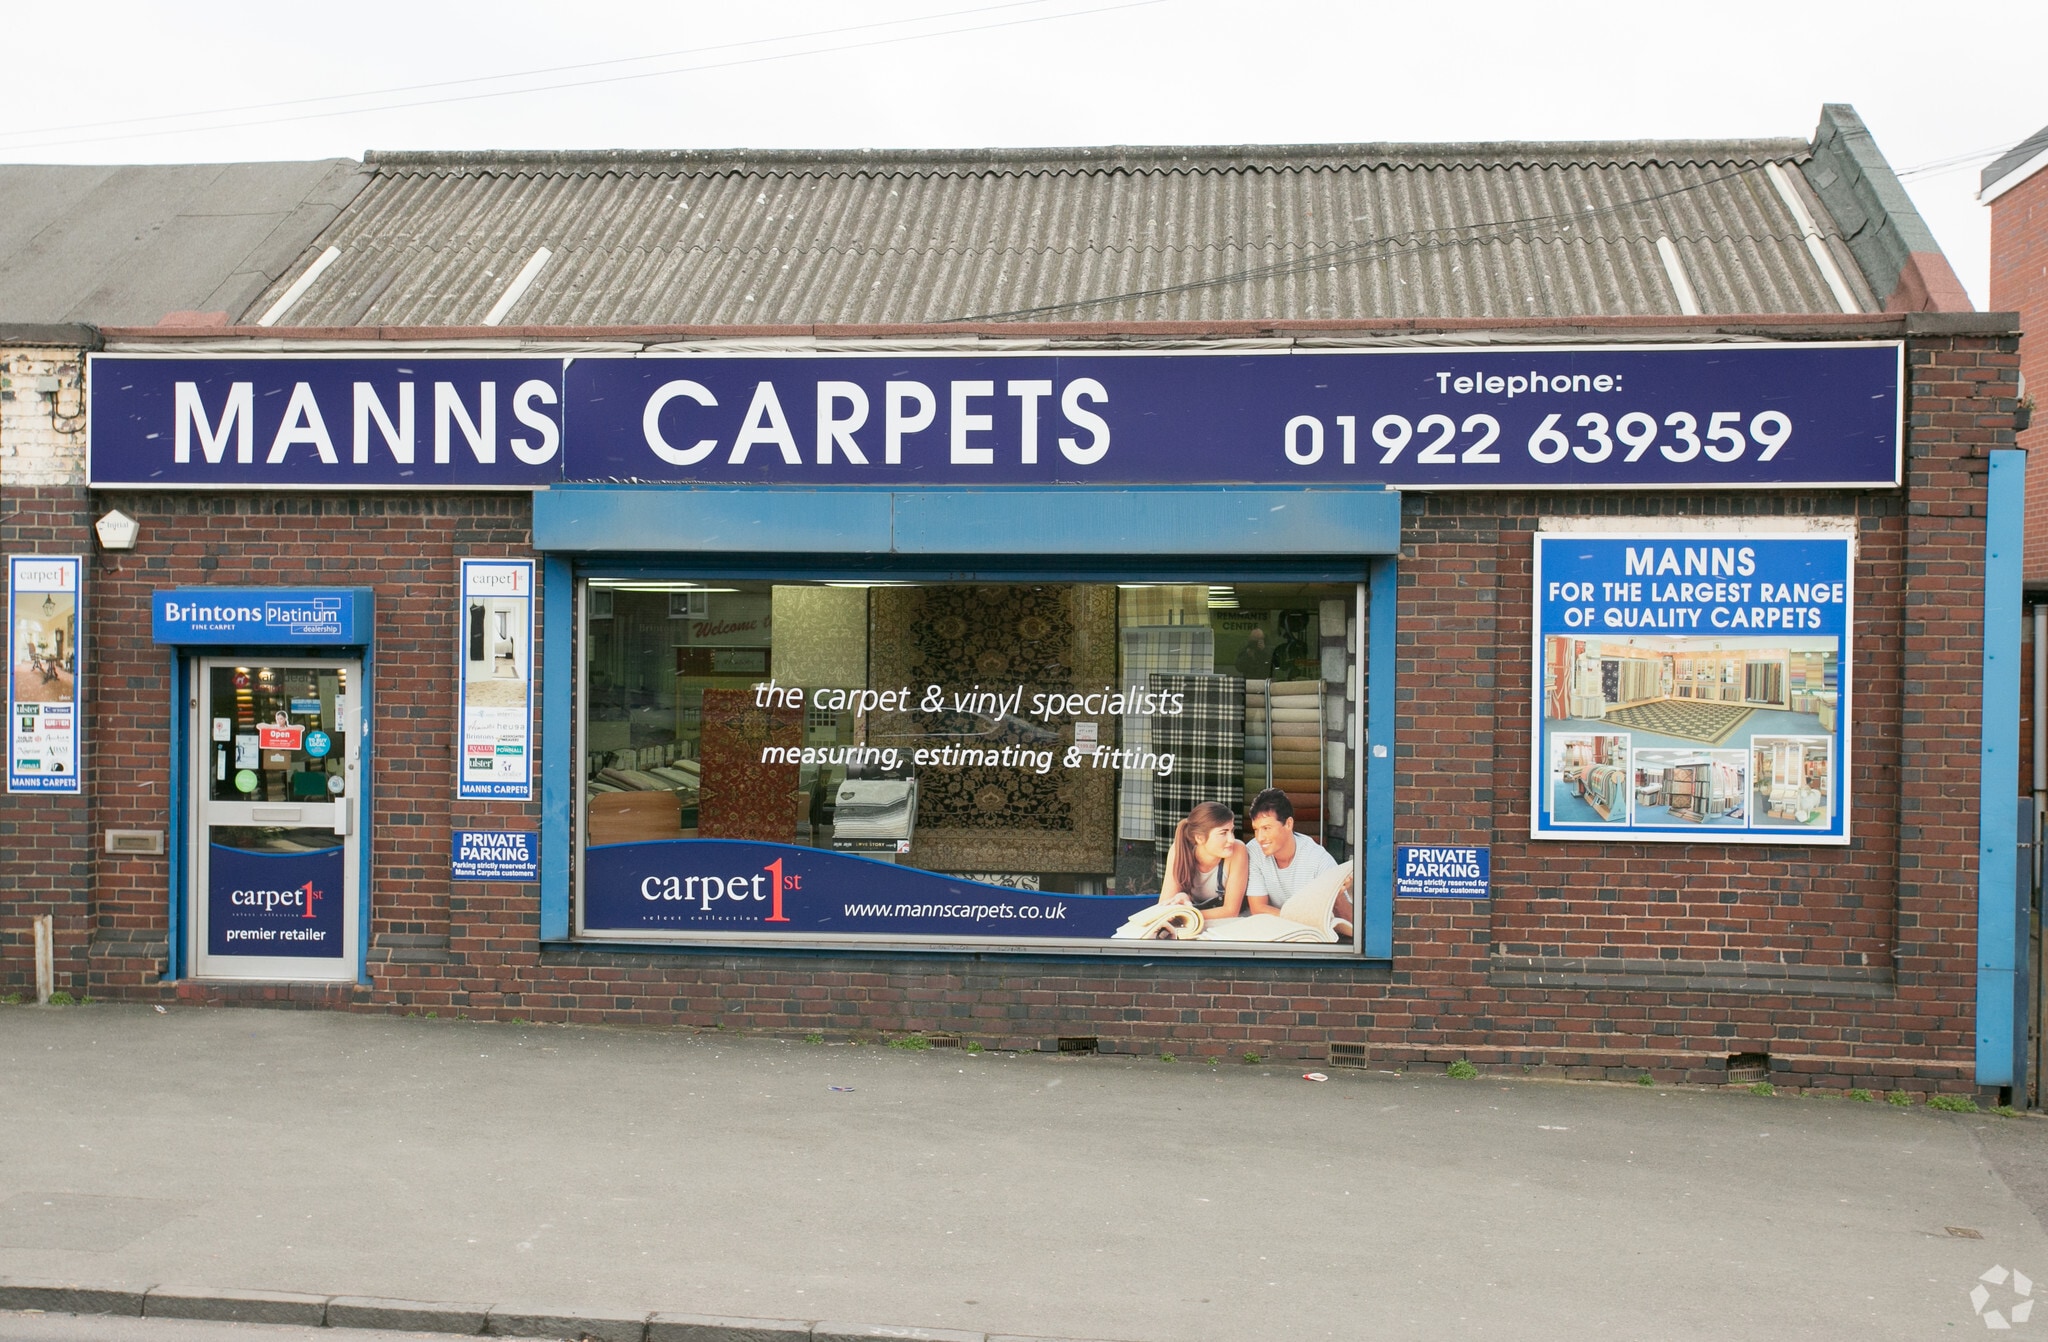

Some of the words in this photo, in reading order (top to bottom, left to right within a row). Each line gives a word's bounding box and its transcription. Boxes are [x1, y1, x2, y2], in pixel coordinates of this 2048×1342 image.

[1436, 371, 1623, 398] Telephone:
[174, 379, 560, 466] MANNS
[642, 377, 1111, 466] CARPETS
[1284, 413, 1501, 466] 01922
[1527, 410, 1793, 463] 639359
[1625, 547, 1756, 577] MANNS
[1549, 582, 1594, 602] FOR
[1602, 582, 1642, 602] THE
[1651, 583, 1752, 603] LARGEST
[1761, 583, 1844, 603] RANGE
[165, 602, 262, 621] Brintons
[268, 607, 337, 622] Platinum
[1563, 607, 1595, 628] OF
[1603, 608, 1702, 628] QUALITY
[1710, 607, 1821, 628] CARPETS
[303, 625, 338, 634] dealership
[692, 619, 758, 638] Welcome
[755, 678, 803, 708] the
[813, 686, 911, 718] carpet
[920, 685, 945, 712] &
[954, 684, 1023, 721] vinyl
[1030, 685, 1184, 722] specialists
[270, 730, 290, 738] Open
[761, 742, 904, 771] measuring,
[914, 743, 1053, 774] estimating
[1062, 745, 1082, 769] &
[1091, 744, 1175, 776] fitting
[12, 778, 40, 787] MANNS
[43, 778, 76, 787] CARPETS
[462, 785, 492, 794] MANNS
[494, 785, 528, 794] CARPETS
[462, 833, 526, 847] PRIVATE
[460, 847, 529, 861] PARKING
[1408, 849, 1477, 863] PRIVATE
[452, 862, 476, 870] Parking
[477, 862, 498, 870] strictly
[476, 869, 500, 877] Carpets
[1406, 863, 1480, 878] PARKING
[1397, 878, 1422, 886] Parking
[1423, 886, 1449, 894] Carpets
[844, 902, 1067, 922] www.mannscarpets.co.uk
[226, 928, 276, 941] premier
[280, 928, 326, 941] retailer
